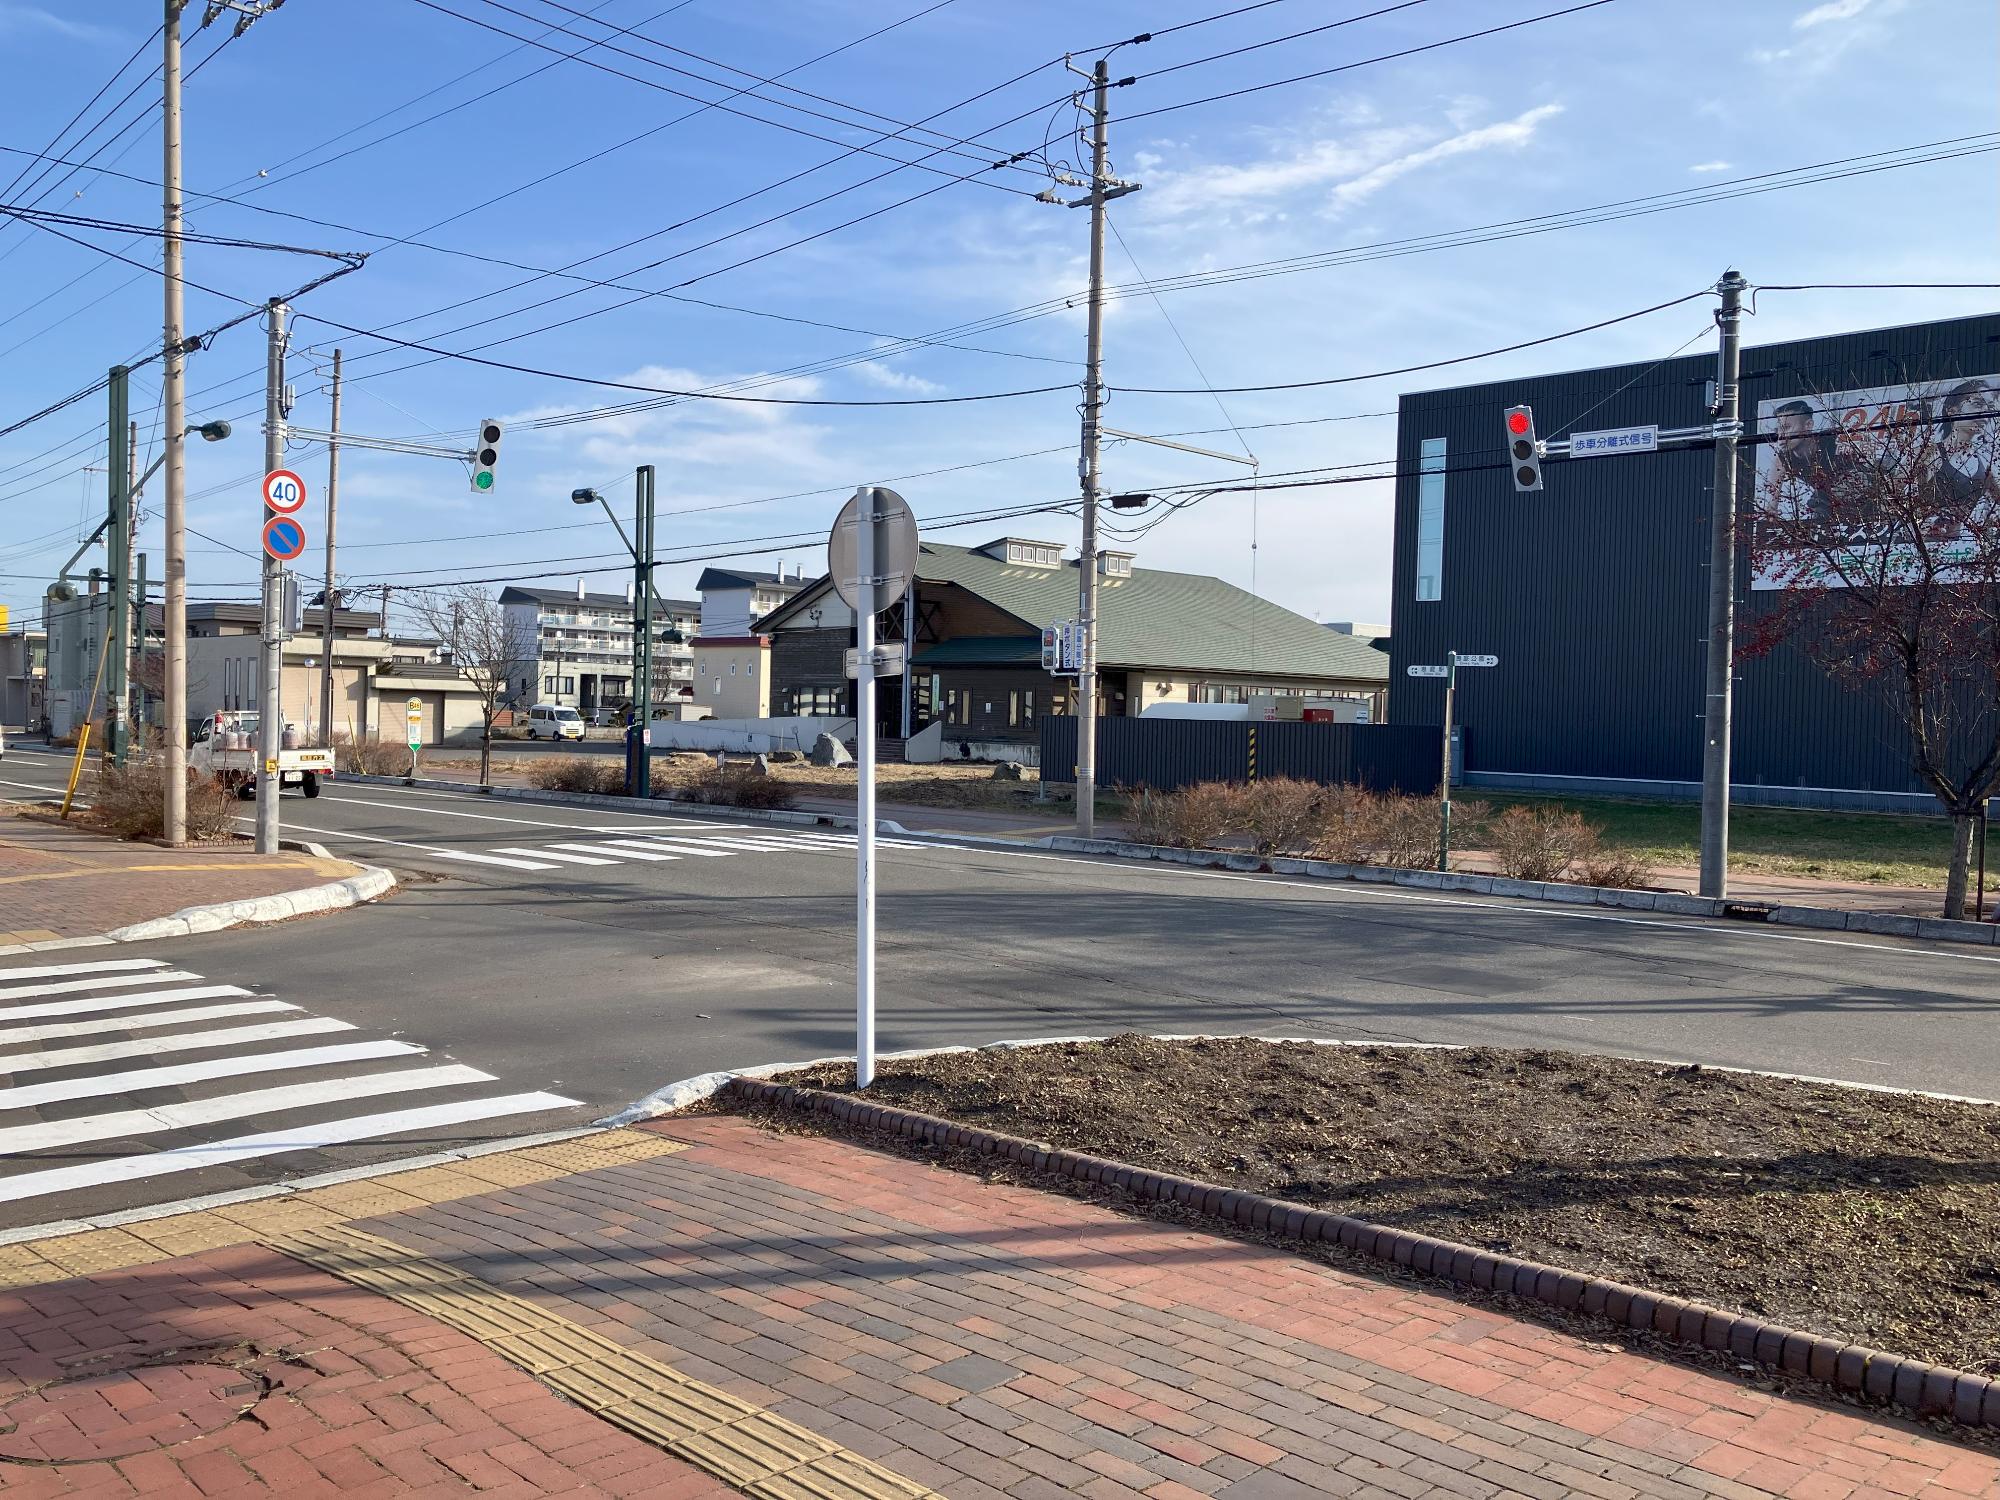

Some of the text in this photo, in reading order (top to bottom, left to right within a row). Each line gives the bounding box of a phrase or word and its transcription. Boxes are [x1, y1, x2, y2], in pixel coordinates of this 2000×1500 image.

[1838, 403, 1921, 443] 24h
[1575, 432, 1653, 451] 歩車分離式信号
[272, 481, 297, 503] 40
